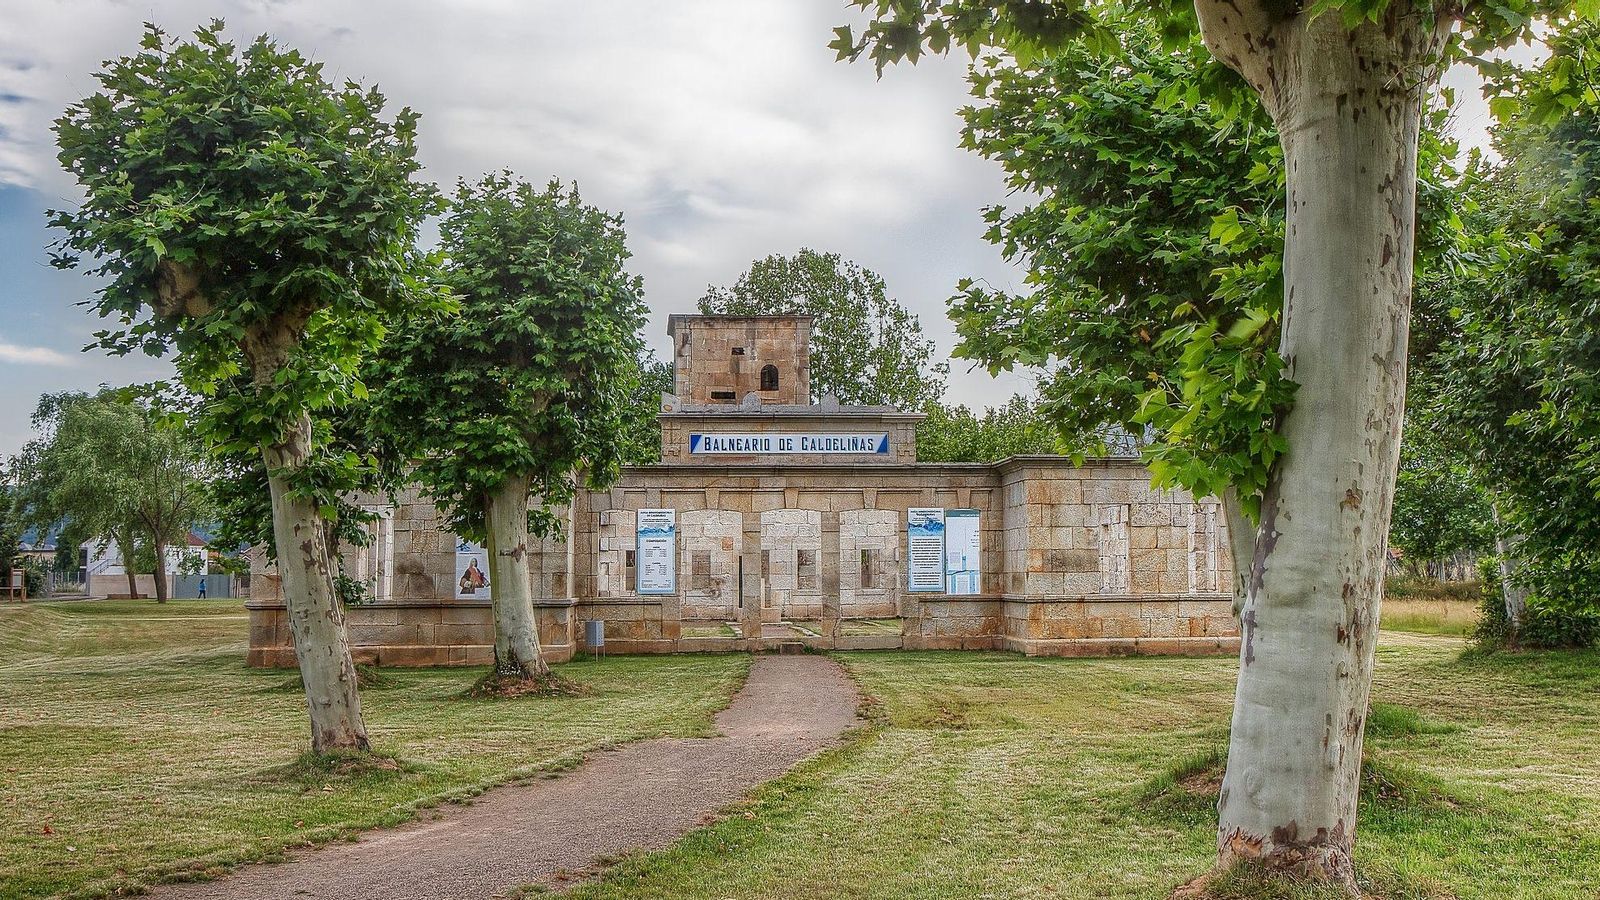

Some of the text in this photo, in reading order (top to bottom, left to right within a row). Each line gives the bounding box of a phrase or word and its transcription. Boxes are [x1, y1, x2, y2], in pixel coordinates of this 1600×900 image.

[704, 436, 875, 451] BALNEARIO DE CALDELIÑAS
